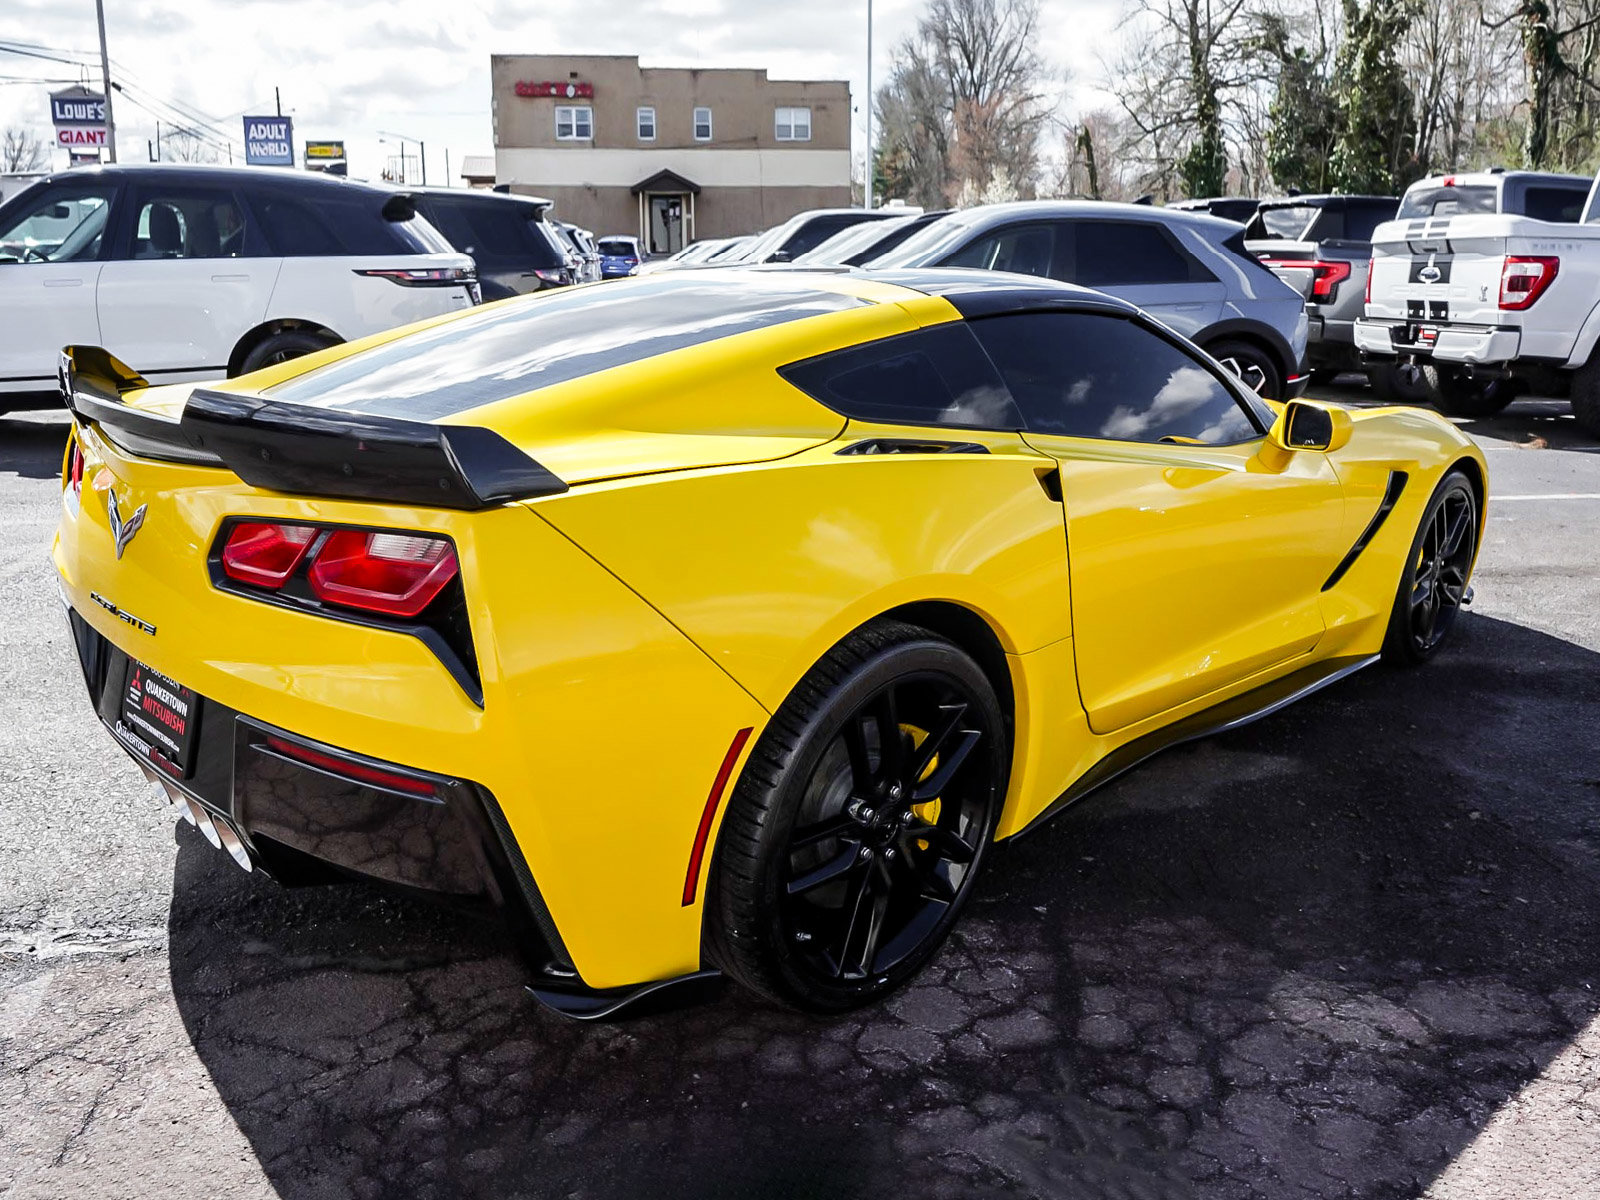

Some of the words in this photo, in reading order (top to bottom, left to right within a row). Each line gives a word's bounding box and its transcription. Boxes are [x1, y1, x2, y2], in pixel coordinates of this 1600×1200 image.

[55, 101, 105, 119] LOWE'S
[59, 130, 106, 144] GIANT
[249, 124, 287, 140] ADULT
[249, 142, 289, 156] WORLD
[145, 678, 188, 717] QUAKERTOWN
[142, 694, 186, 736] MITSUBISHI
